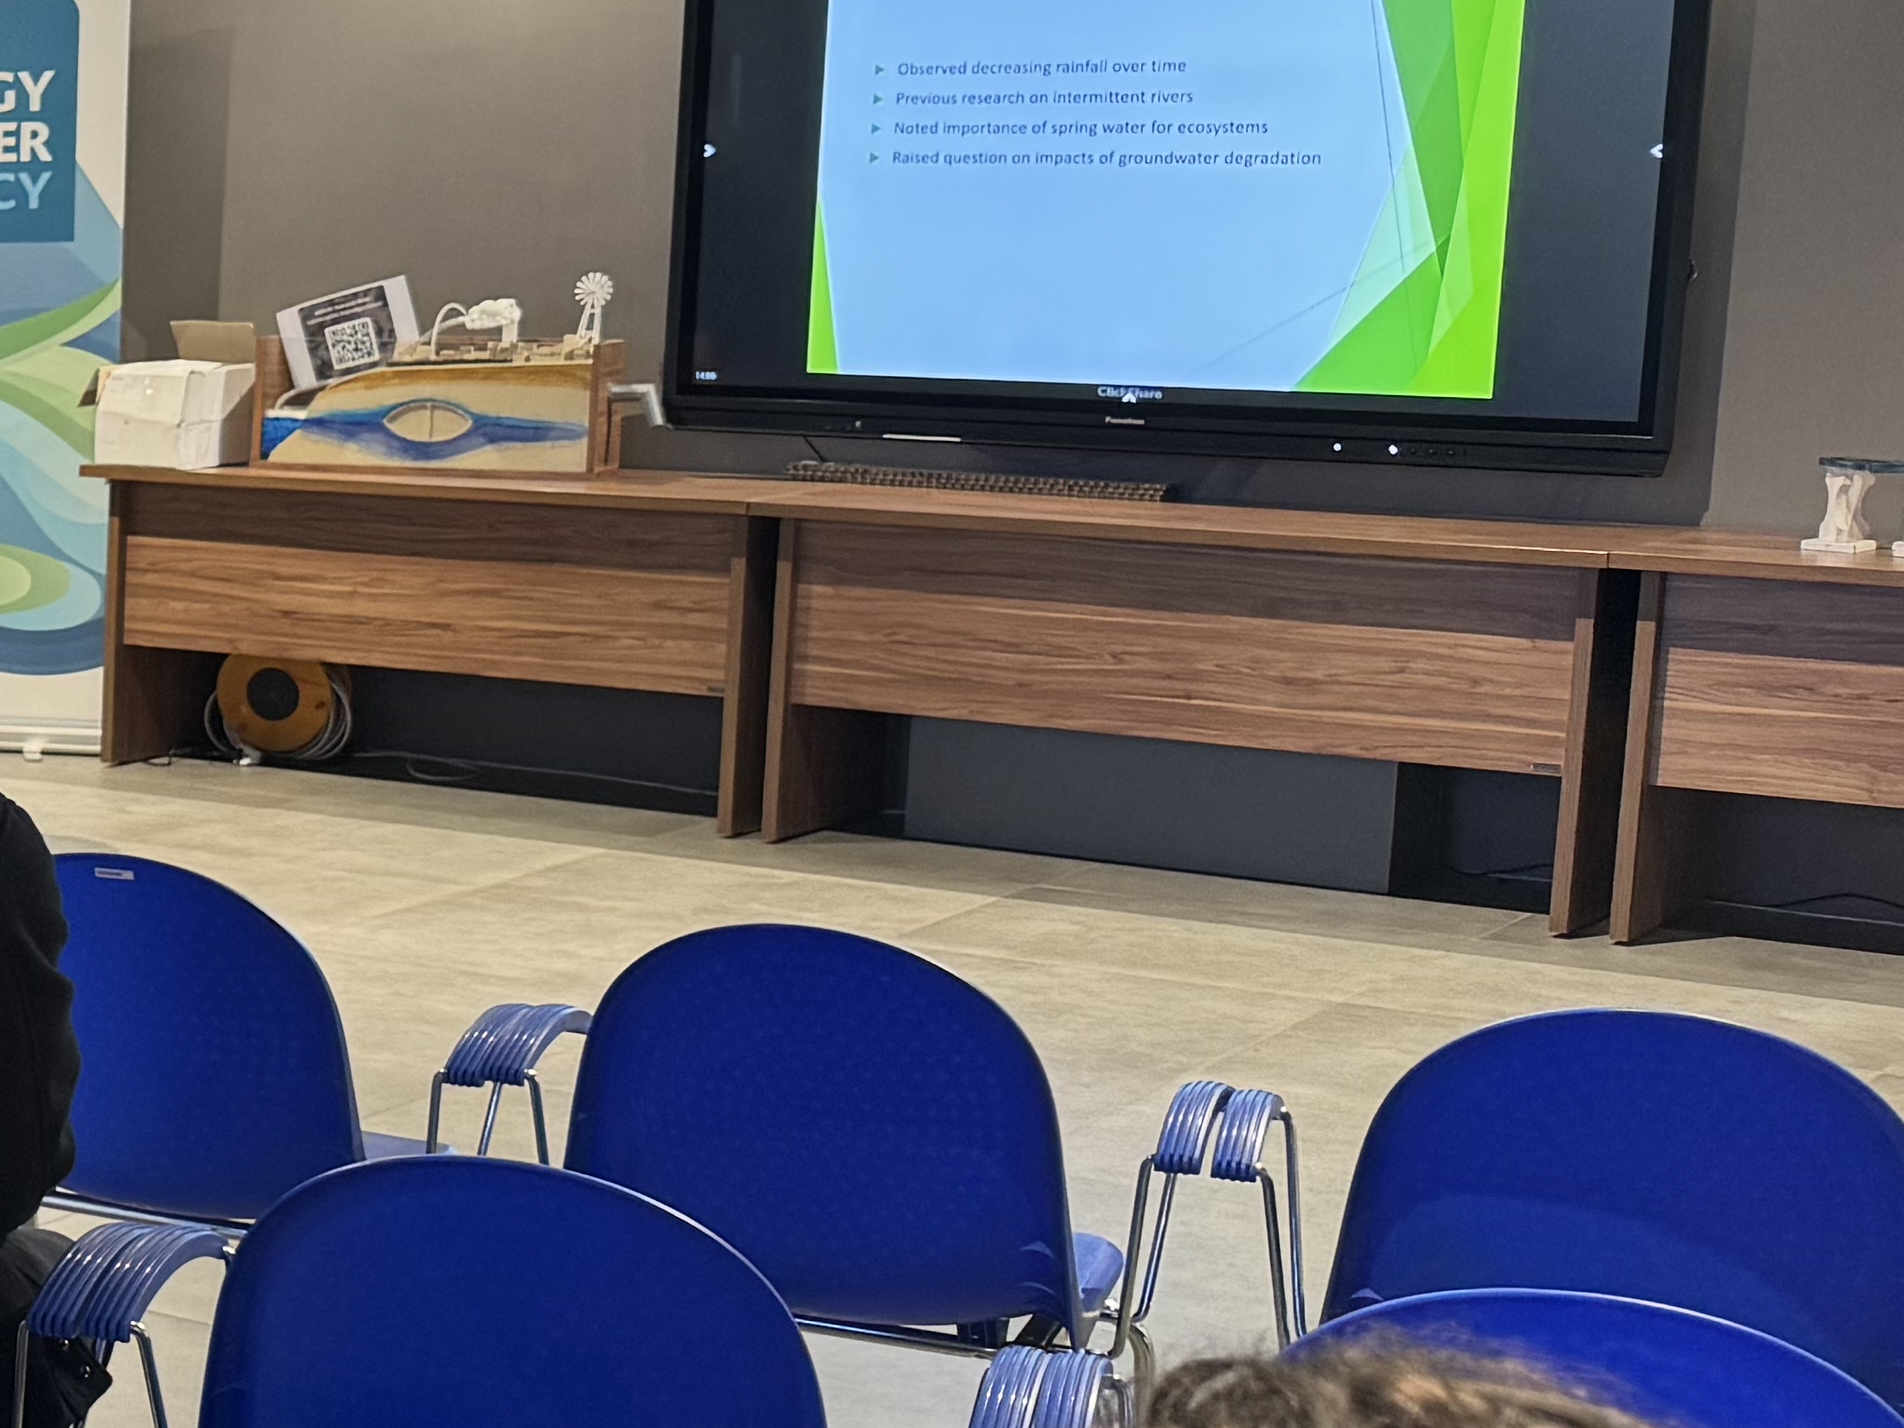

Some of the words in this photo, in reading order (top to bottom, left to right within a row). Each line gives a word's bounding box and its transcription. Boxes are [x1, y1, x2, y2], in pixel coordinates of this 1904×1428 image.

[898, 62, 967, 76] Observed
[971, 61, 1052, 76] decreasing
[1056, 60, 1108, 74] rainfall
[1112, 61, 1146, 73] over
[1152, 60, 1187, 73] time
[896, 92, 957, 105] Previous
[962, 91, 1025, 105] research
[1029, 93, 1048, 104] on
[1053, 90, 1146, 104] intermittent
[1151, 90, 1194, 103] rivers
[894, 122, 938, 135] Noted
[943, 122, 1027, 138] importance
[1031, 121, 1047, 134] of
[1051, 121, 1098, 137] spring
[1102, 122, 1146, 134] water
[1151, 120, 1173, 134] for
[1178, 121, 1268, 137] ecosystems
[892, 152, 940, 165] Raised
[944, 151, 1007, 166] question
[1011, 153, 1030, 164] on
[1035, 152, 1094, 166] impacts
[1099, 151, 1115, 165] of
[1118, 151, 1220, 167] groundwater
[1224, 150, 1322, 167] degradation
